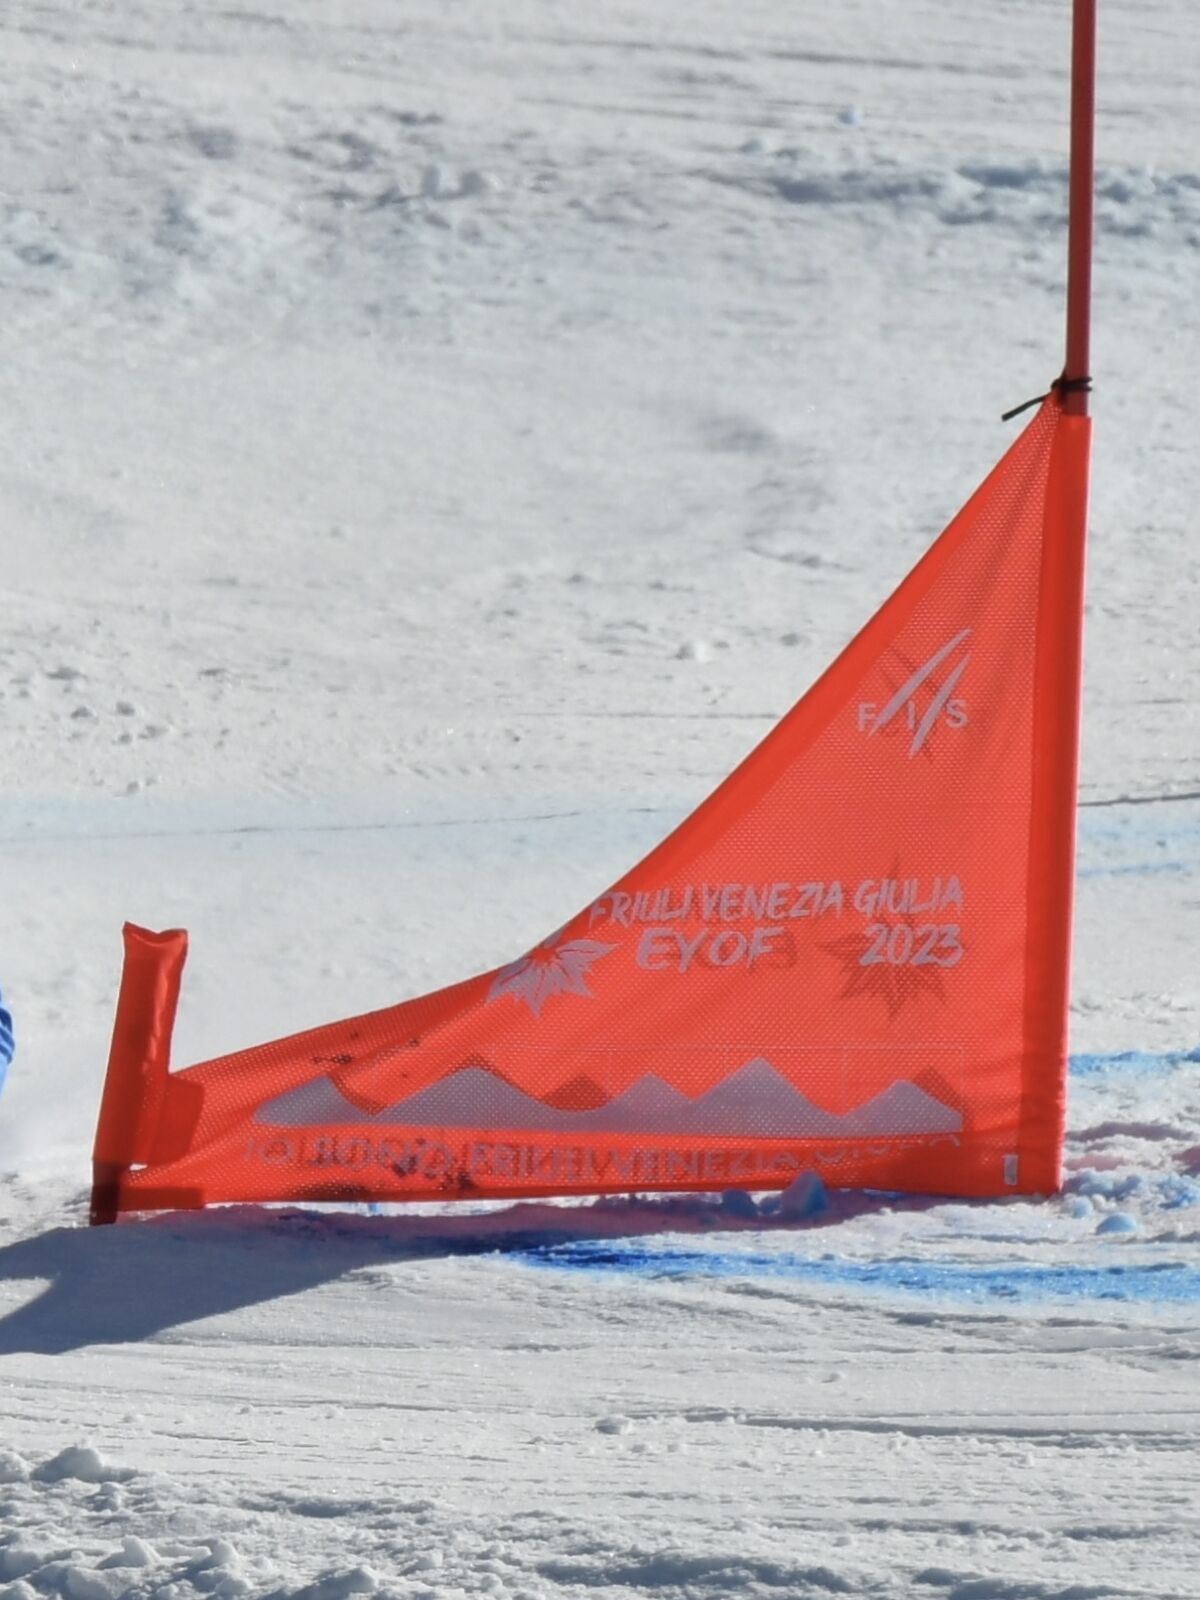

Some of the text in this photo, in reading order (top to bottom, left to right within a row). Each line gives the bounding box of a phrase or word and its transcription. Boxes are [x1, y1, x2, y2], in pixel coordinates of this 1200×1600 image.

[589, 874, 965, 927] FRIULI VENEZIA GIULIA
[636, 927, 785, 971] EYOF
[858, 923, 966, 968] 2023
